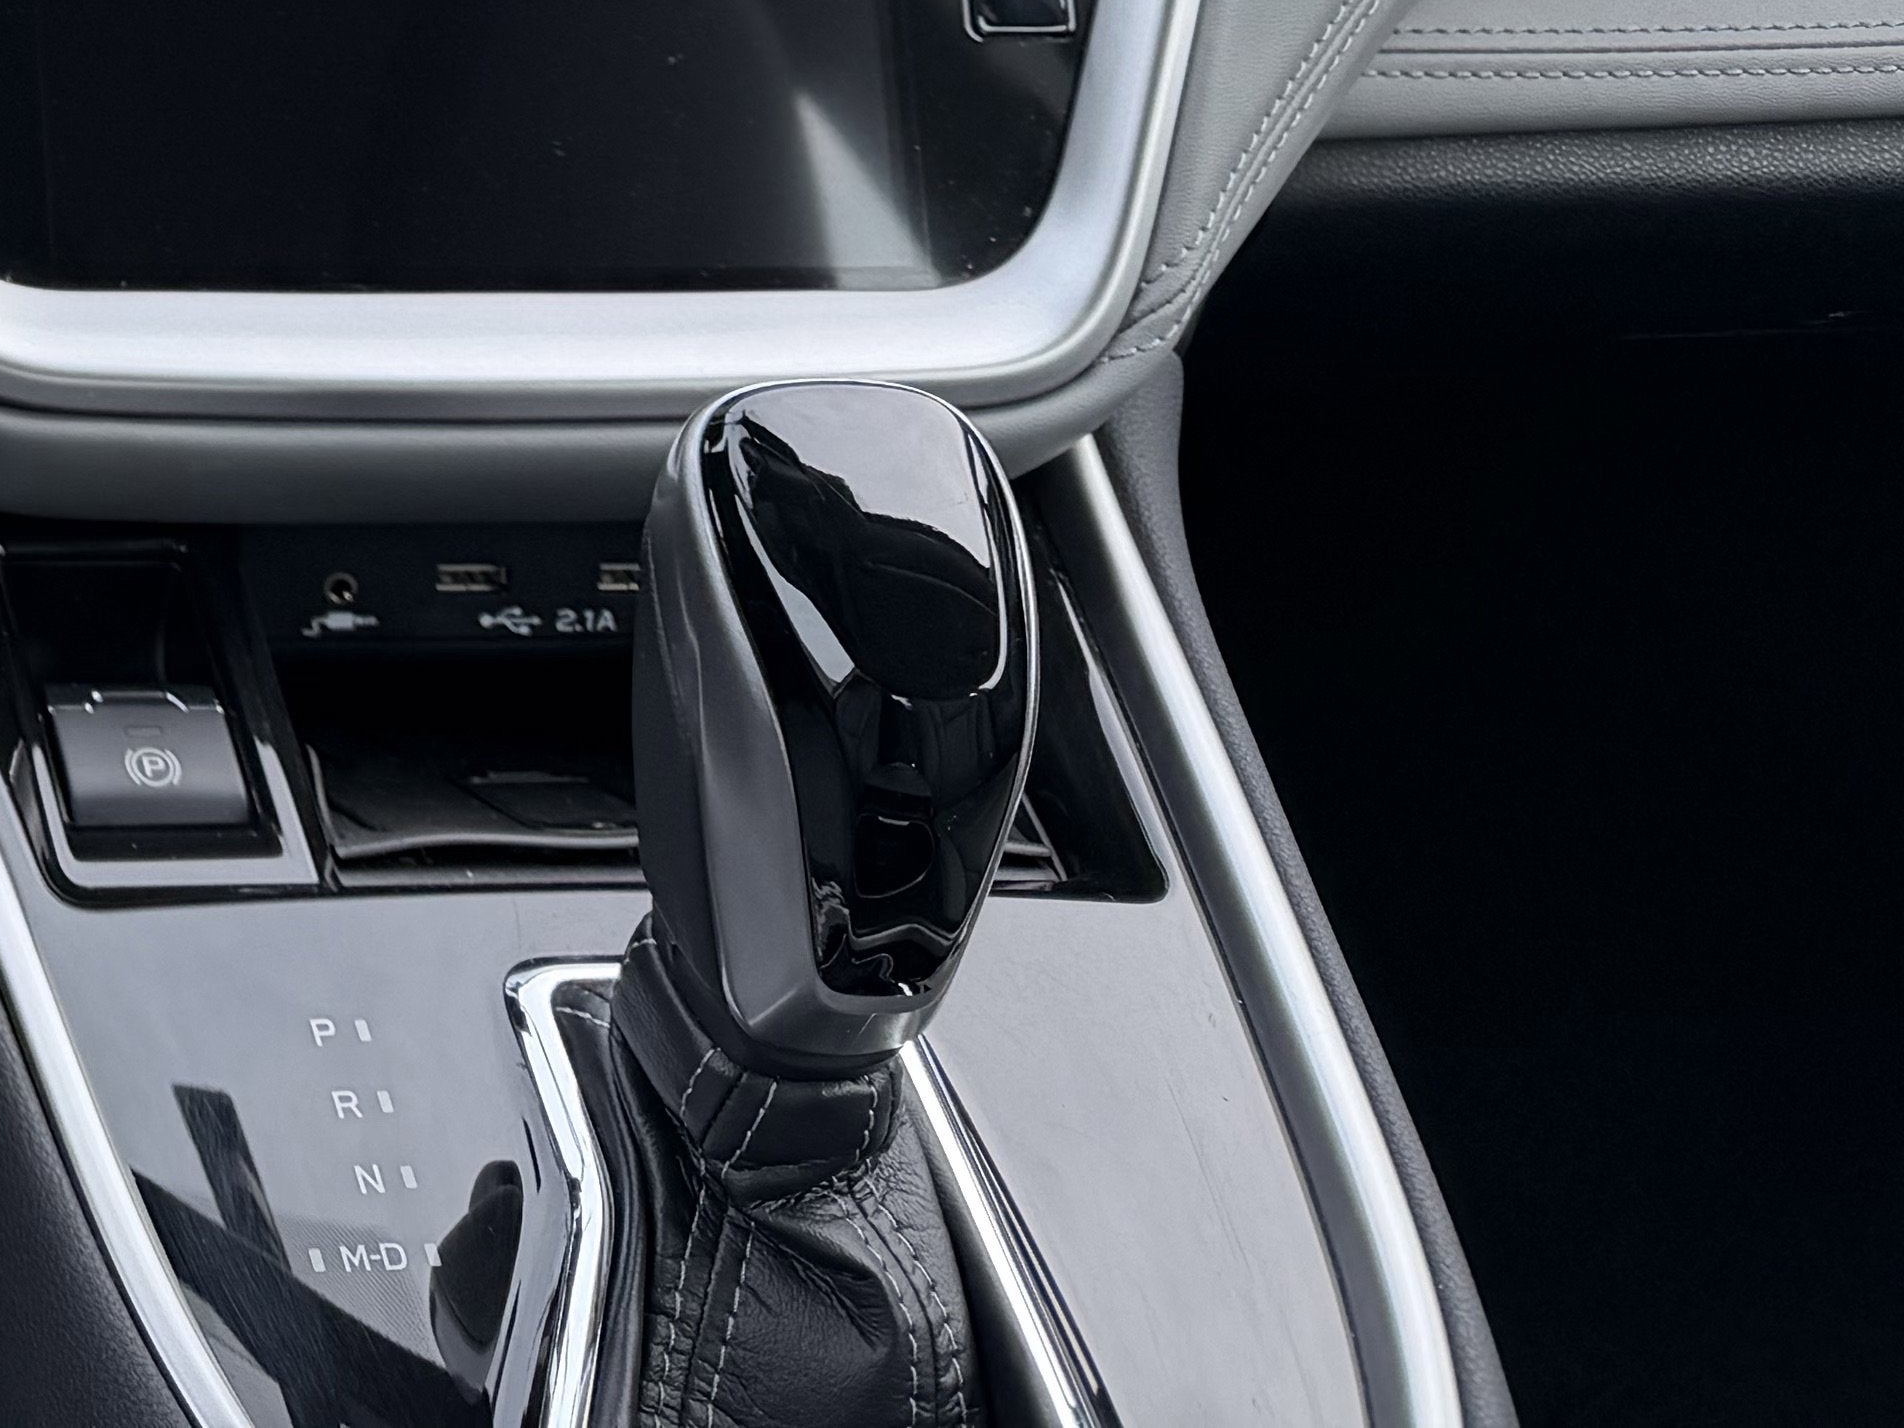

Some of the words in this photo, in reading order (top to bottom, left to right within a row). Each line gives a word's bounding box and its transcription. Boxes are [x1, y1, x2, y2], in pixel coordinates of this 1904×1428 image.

[555, 607, 617, 633] 2.1A
[308, 1017, 336, 1048] P
[331, 1089, 364, 1120] R
[353, 1162, 387, 1196] N
[340, 1242, 408, 1273] M-D
